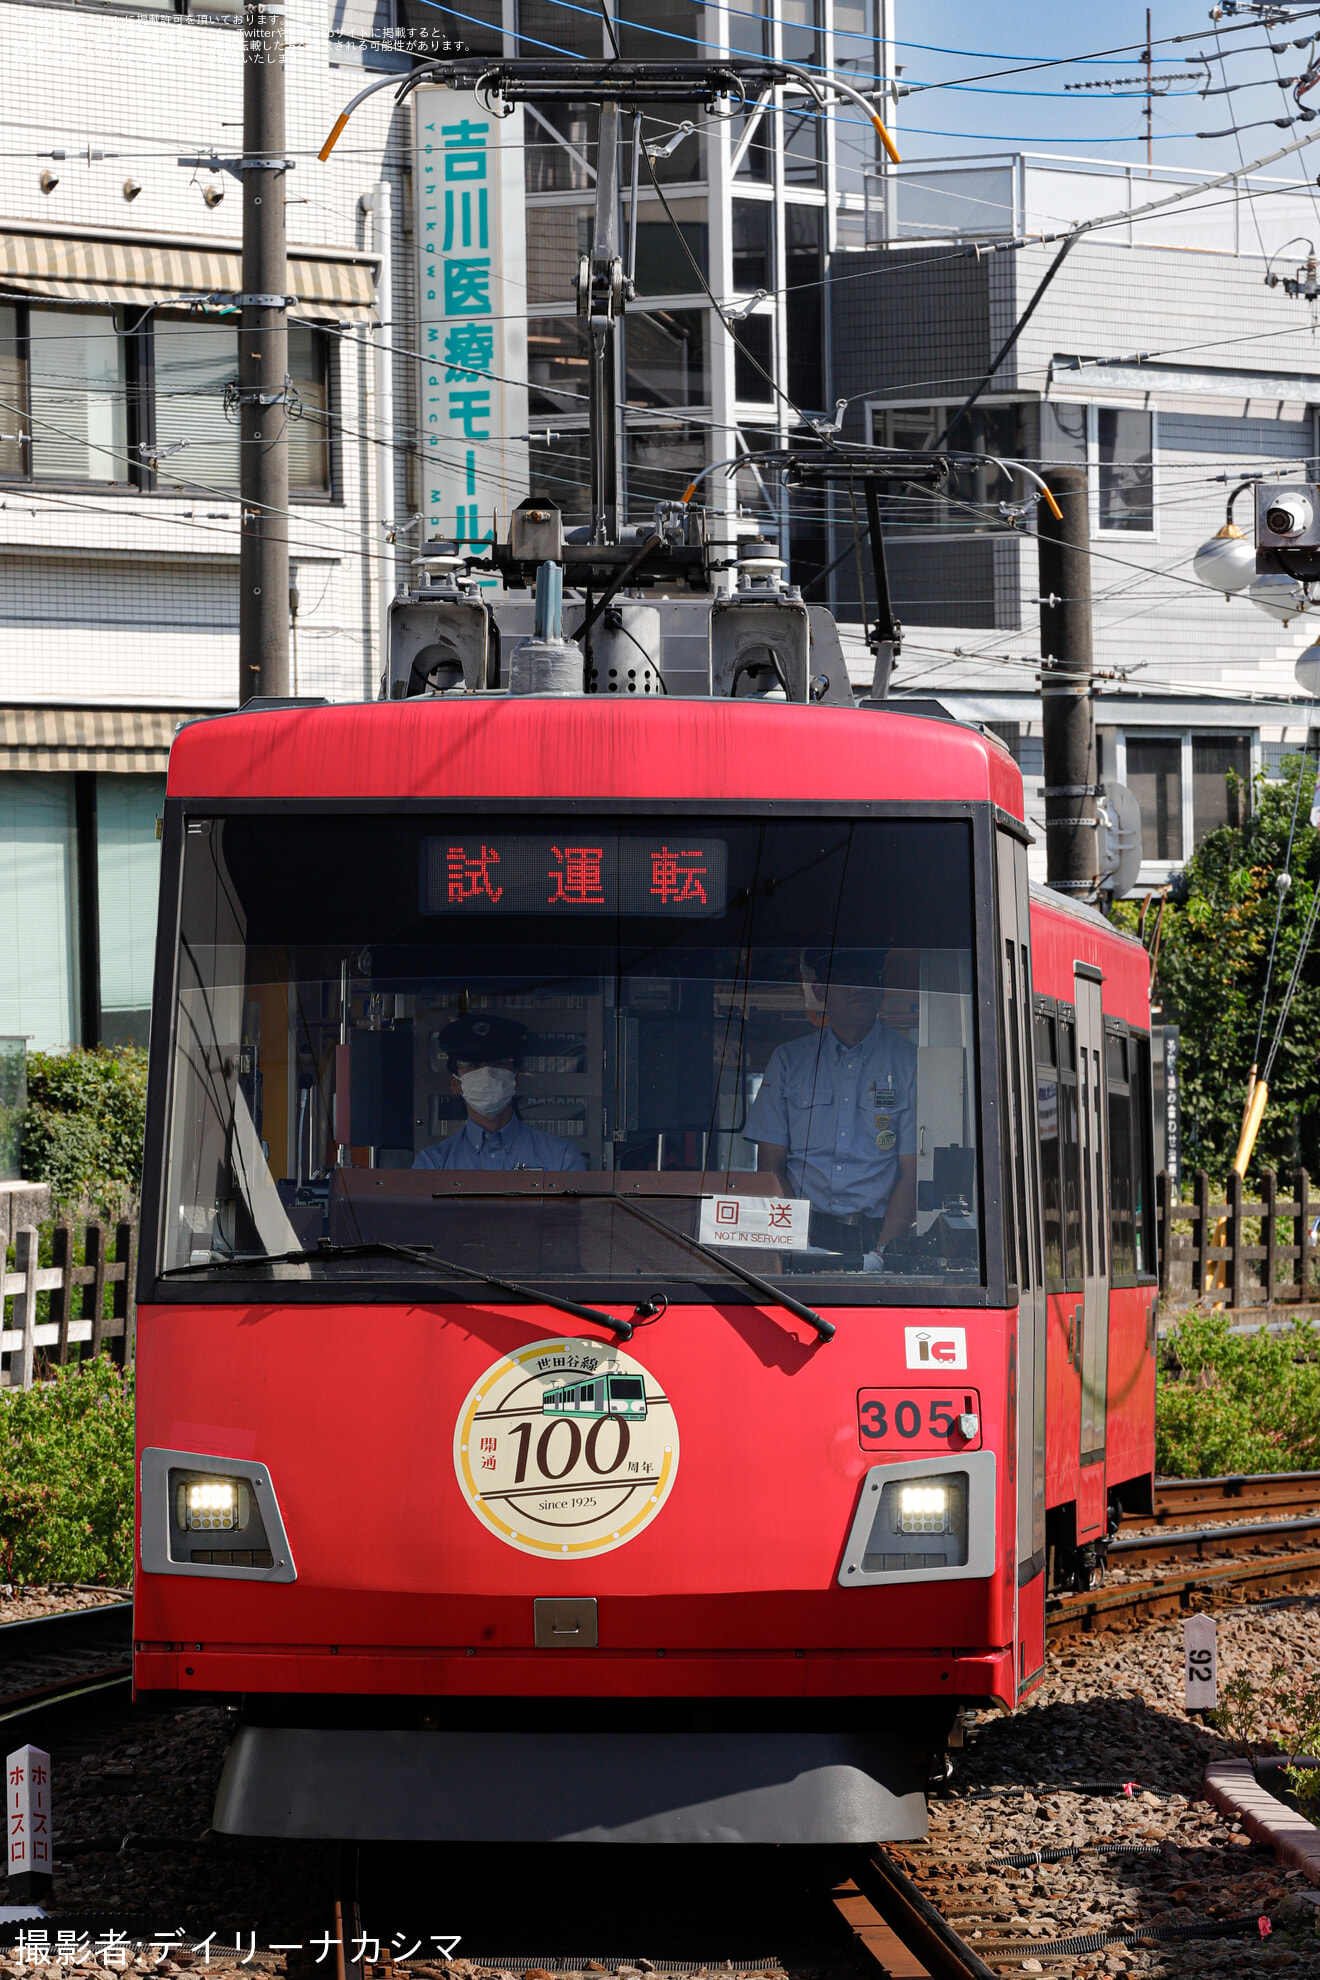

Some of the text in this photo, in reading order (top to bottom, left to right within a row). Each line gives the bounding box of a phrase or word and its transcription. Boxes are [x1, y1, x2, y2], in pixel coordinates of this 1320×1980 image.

[425, 122, 437, 300] Yoshikawa
[446, 845, 707, 904] 試運転
[715, 1200, 793, 1228] 回送
[714, 1231, 794, 1245] NOT IN SERVICE
[535, 1354, 598, 1372] 世田谷線
[860, 1400, 956, 1439] 305
[479, 1436, 498, 1472] 開通
[507, 1413, 631, 1484] 100
[626, 1460, 655, 1475] 周年
[538, 1496, 598, 1511] since 1925
[1189, 1649, 1213, 1682] 92
